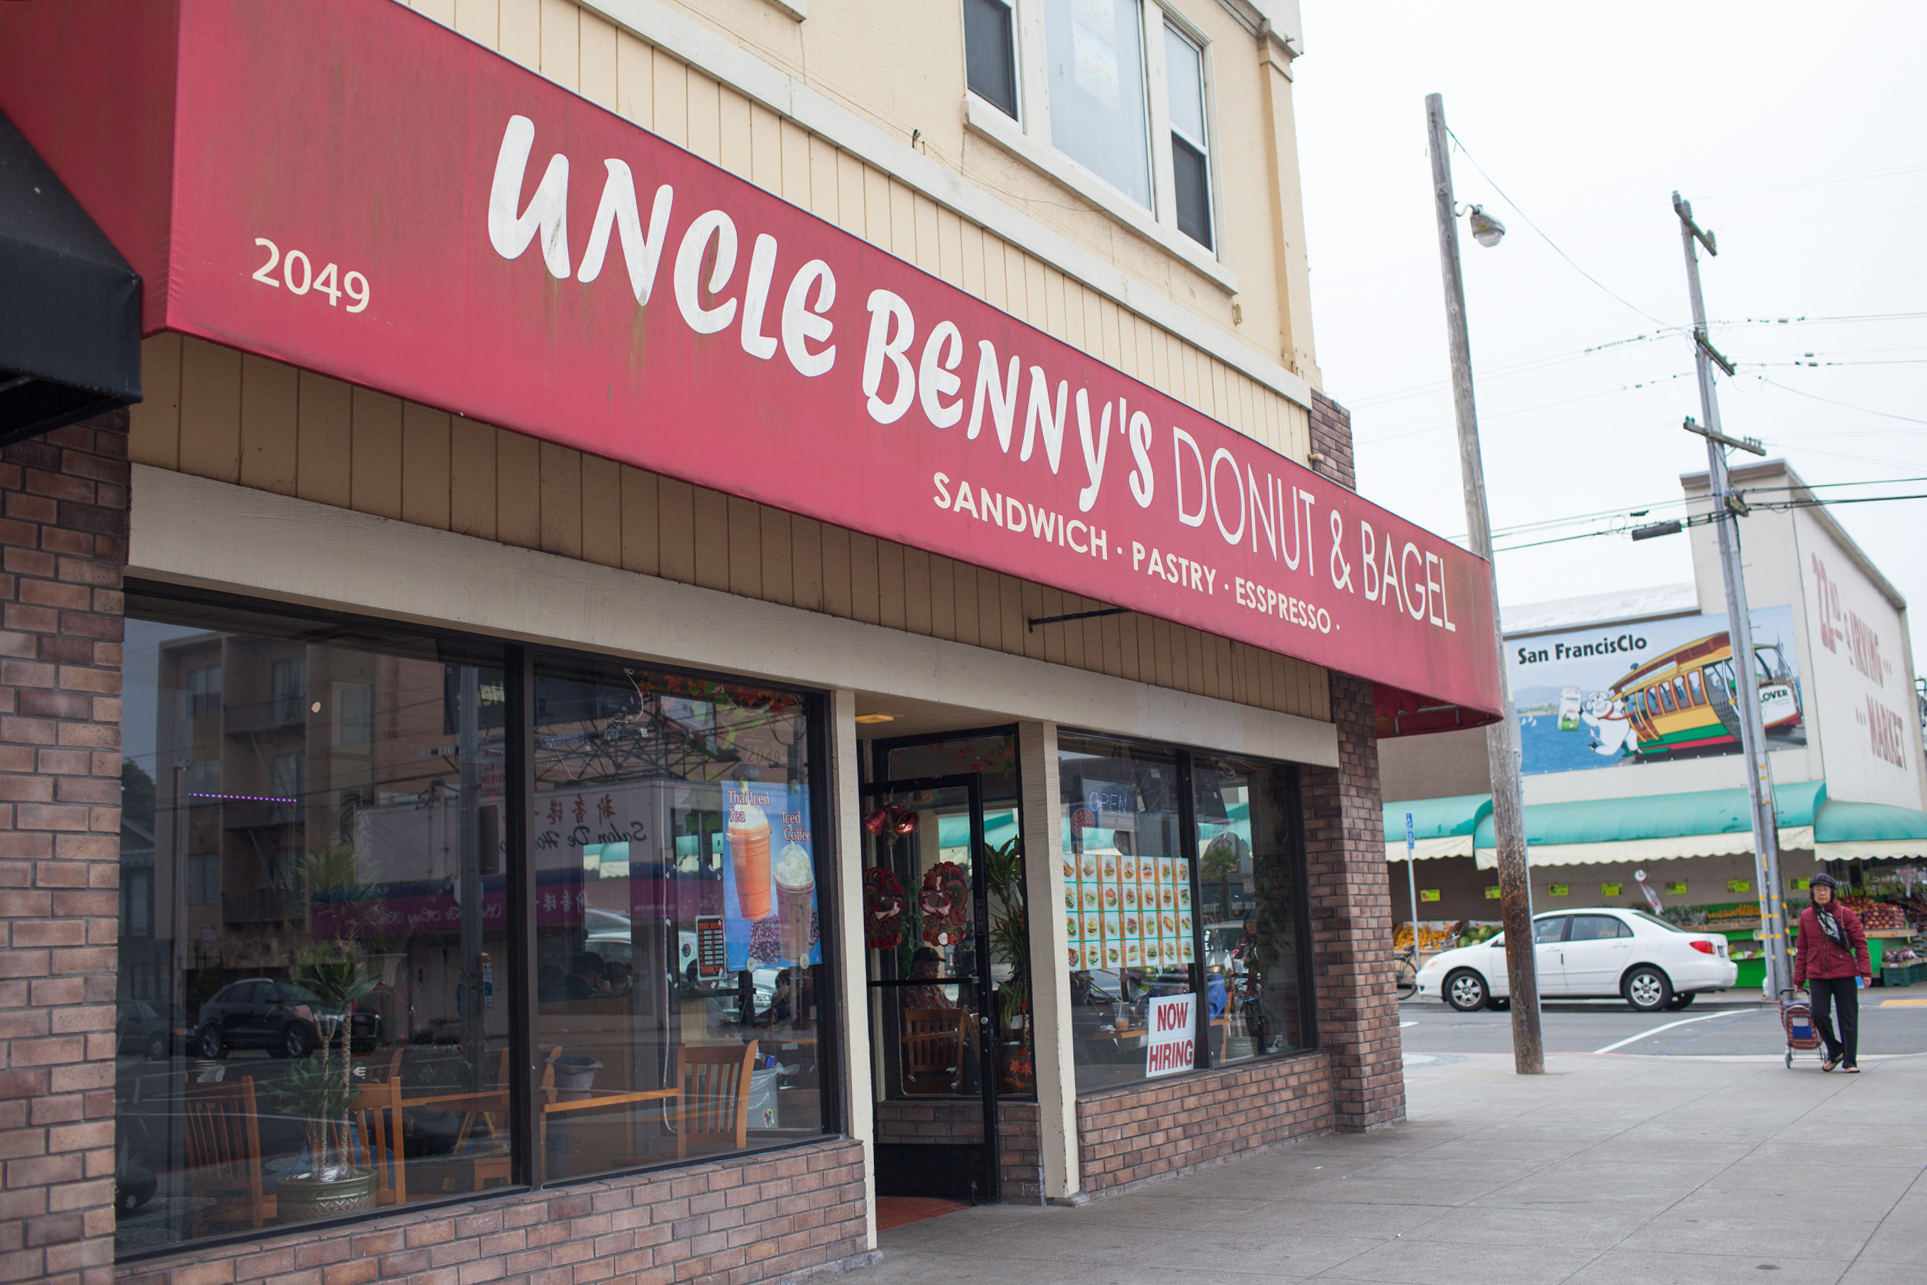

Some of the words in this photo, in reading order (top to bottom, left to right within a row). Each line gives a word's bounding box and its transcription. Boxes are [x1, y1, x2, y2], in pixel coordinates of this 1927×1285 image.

[252, 237, 371, 314] 2049
[488, 115, 837, 378] UNCLE
[862, 288, 1155, 512] BENNY'S
[1173, 426, 1316, 577] DONUT
[1329, 508, 1355, 594] &
[1360, 519, 1457, 633] BAGEL
[932, 471, 1108, 561] SANDWICH
[1132, 540, 1217, 596] PASTRY
[1234, 576, 1332, 635] ESSPRESSO
[1518, 647, 1549, 665] San
[1555, 634, 1647, 662] FrancisClo
[1760, 689, 1789, 703] OVER
[1866, 692, 1908, 772] MARKET
[728, 789, 748, 805] Thai
[749, 790, 770, 805] Iced
[1089, 791, 1127, 815] OPEN
[728, 807, 746, 822] Tea
[782, 809, 801, 824] Iced
[783, 826, 811, 842] Coffee
[1157, 1002, 1189, 1032] NOW
[1148, 1039, 1194, 1073] HIRING
